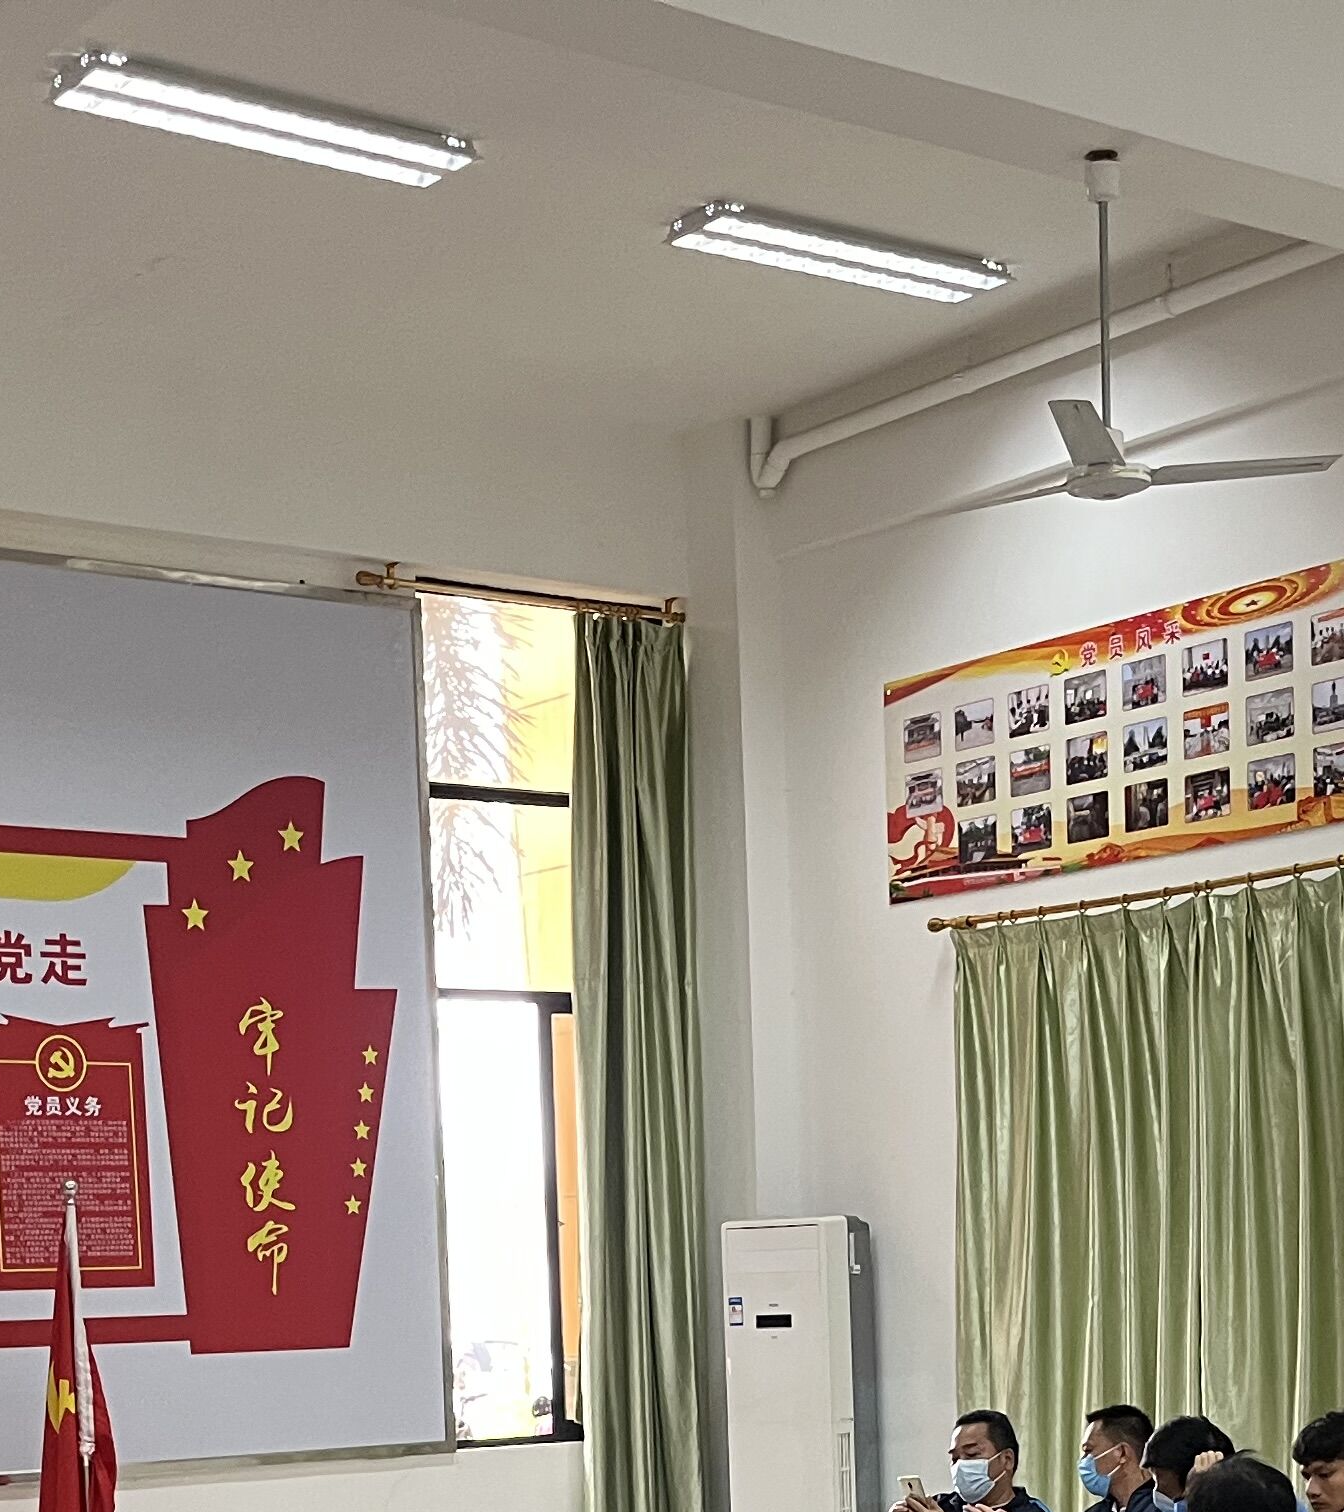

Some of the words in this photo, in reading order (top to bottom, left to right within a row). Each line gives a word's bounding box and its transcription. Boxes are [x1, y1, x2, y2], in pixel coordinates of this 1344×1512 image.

[1079, 620, 1183, 669] 党员风采
[24, 1095, 102, 1117] 党员义务
[234, 996, 297, 1296] 牢记使命
